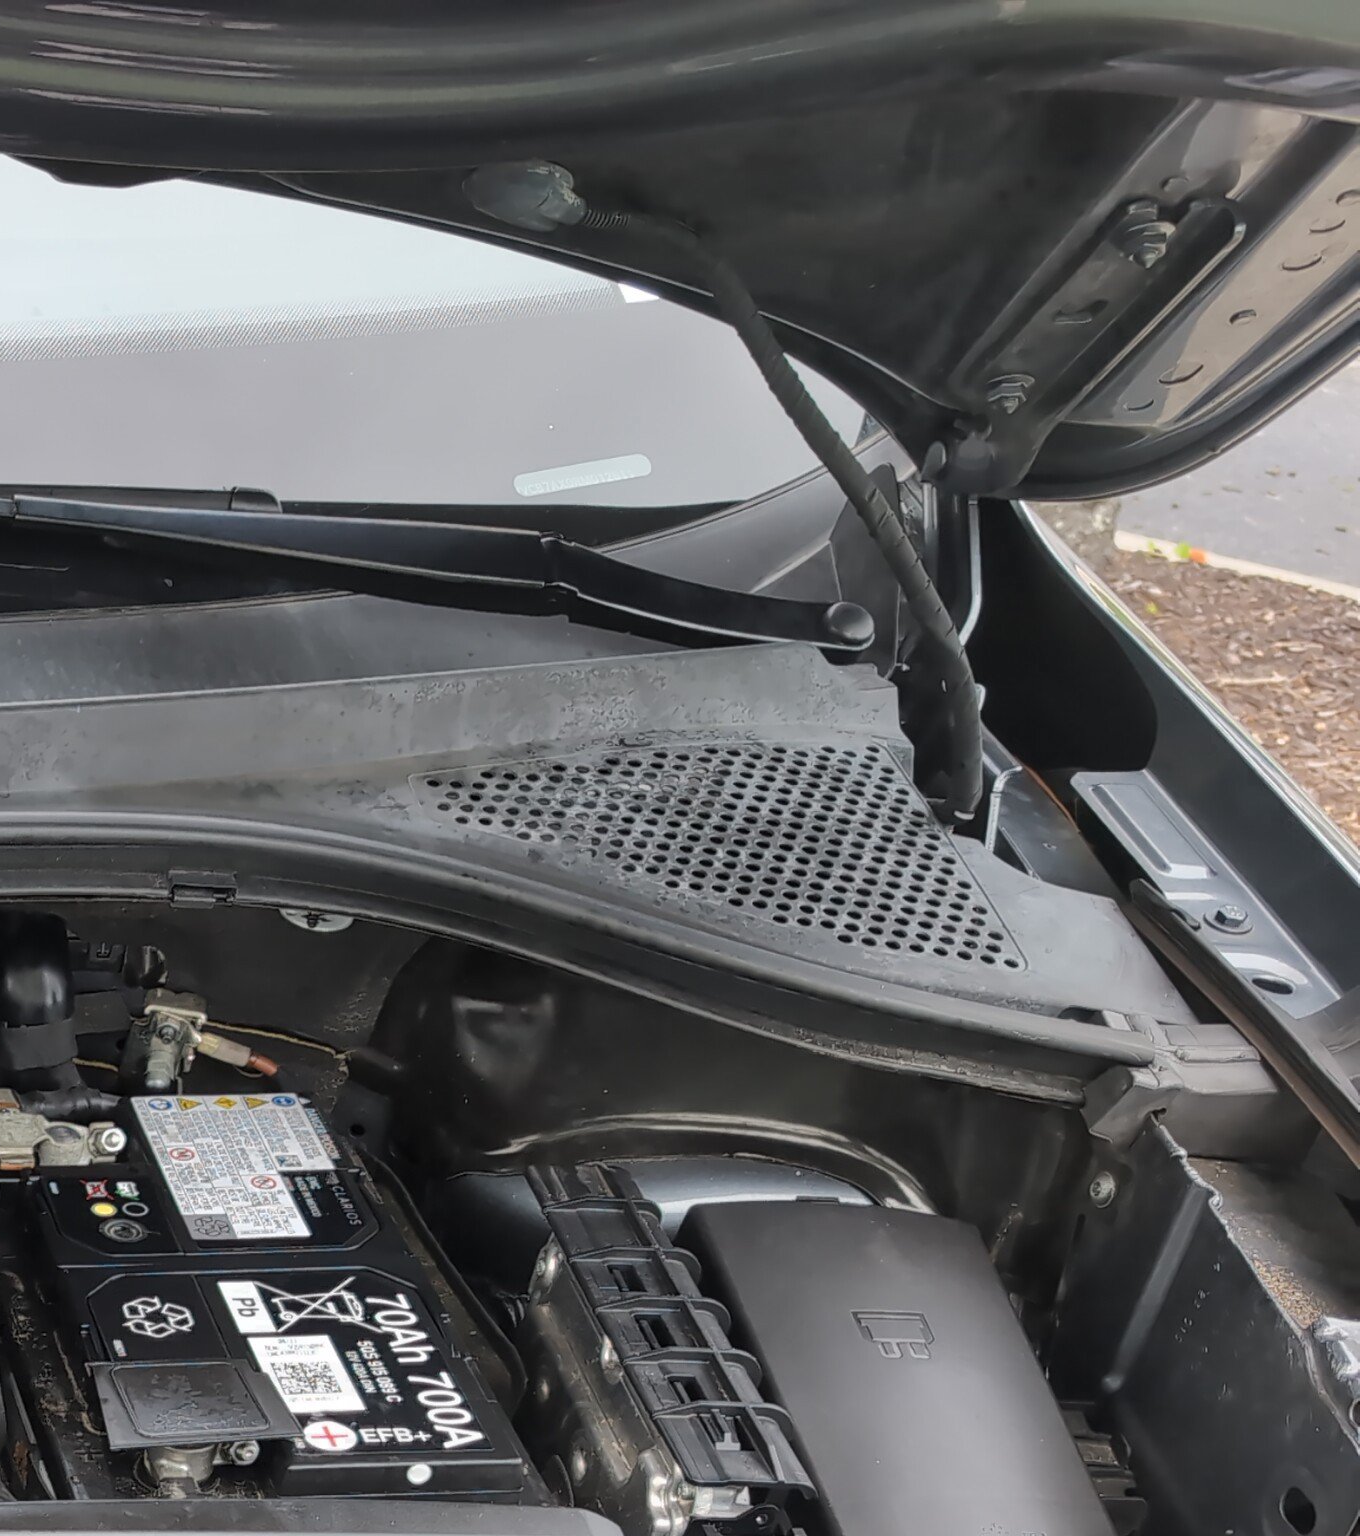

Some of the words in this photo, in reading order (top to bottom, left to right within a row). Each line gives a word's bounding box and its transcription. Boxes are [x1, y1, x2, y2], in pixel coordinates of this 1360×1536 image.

[332, 1185, 363, 1226] CLARIOS
[232, 1297, 260, 1318] Pb
[365, 1293, 436, 1364] 70Ah
[407, 1371, 484, 1449] 700A
[359, 1427, 433, 1444] EFB+
